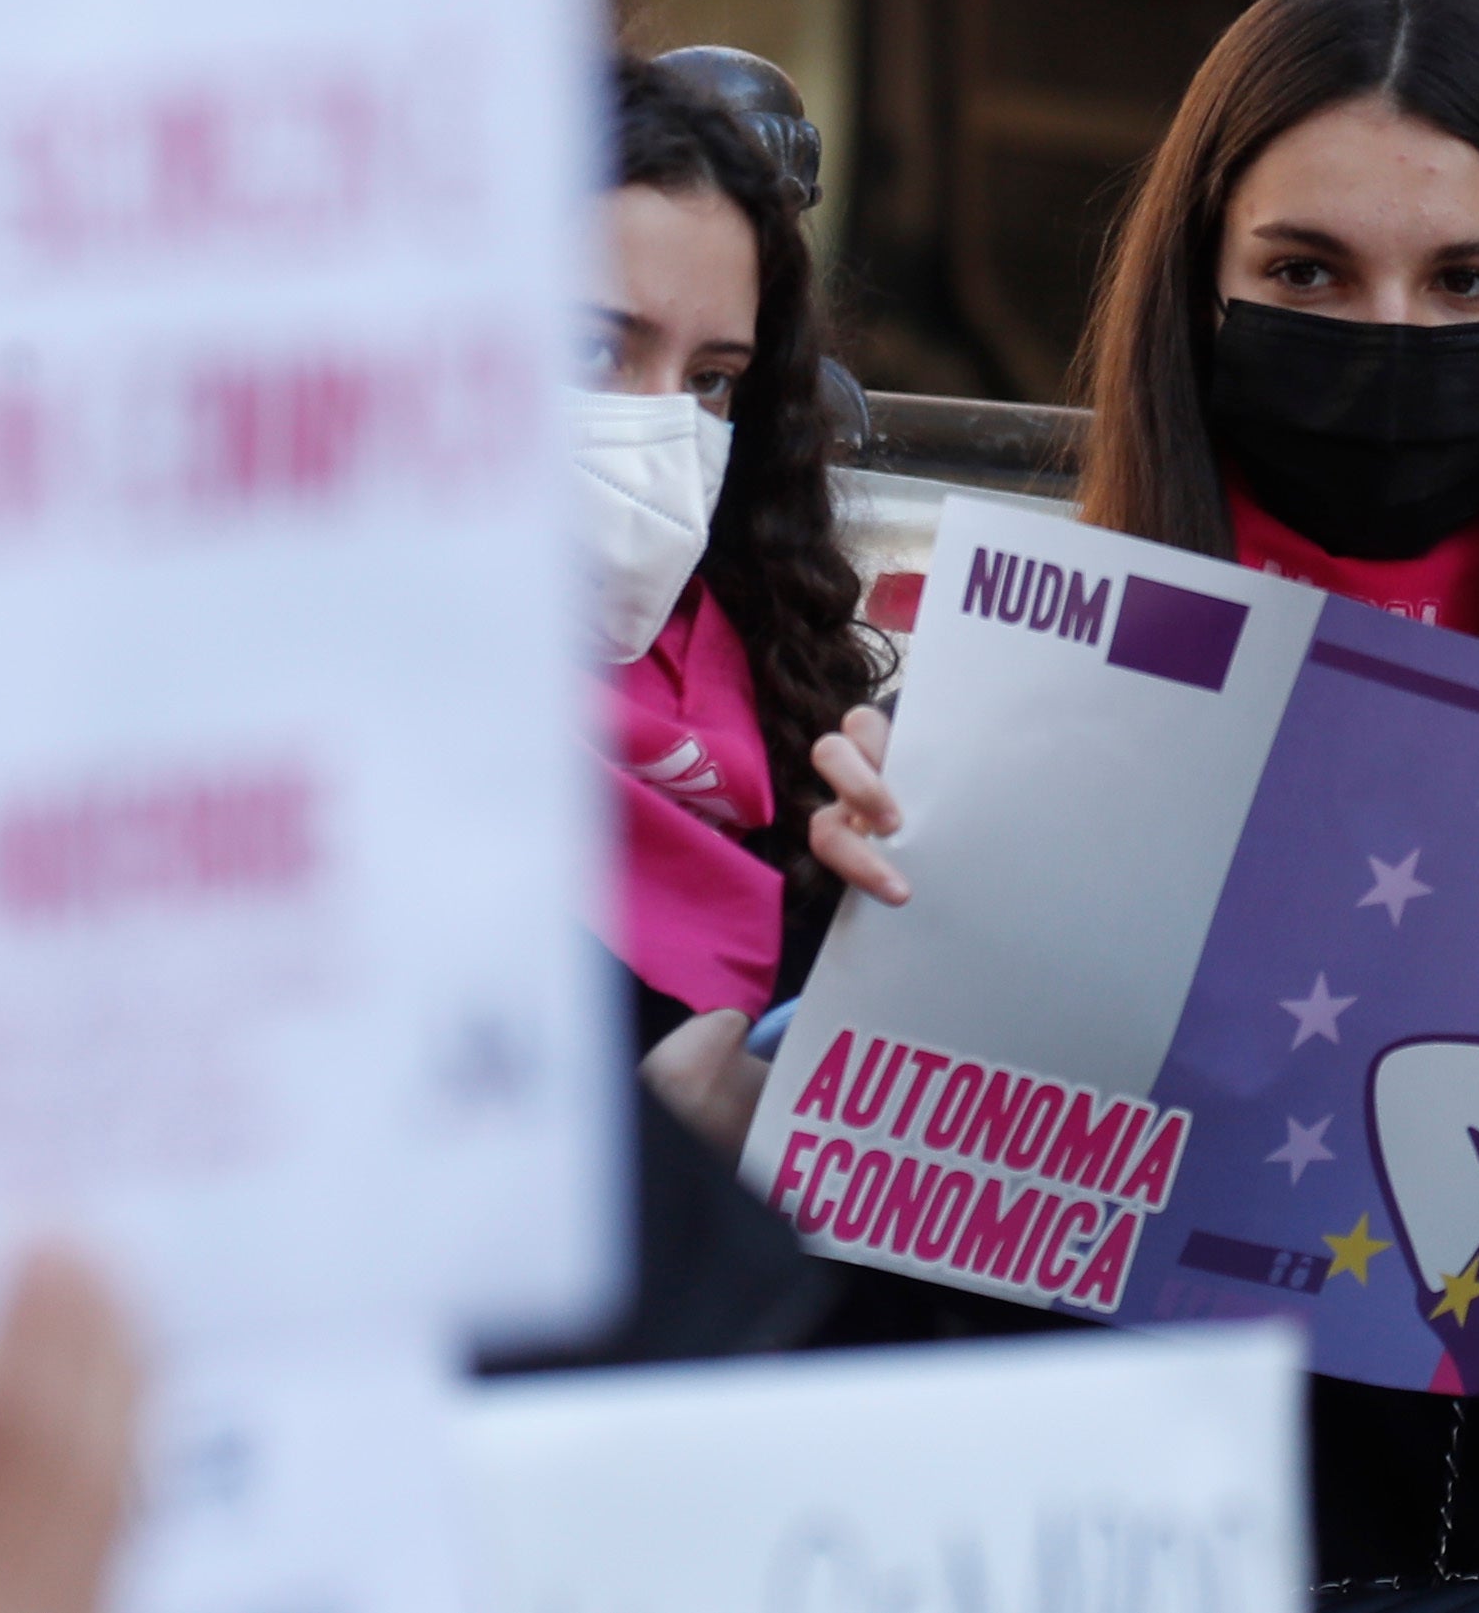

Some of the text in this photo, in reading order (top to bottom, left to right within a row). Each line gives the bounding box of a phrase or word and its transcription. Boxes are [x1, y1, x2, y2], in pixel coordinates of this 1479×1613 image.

[962, 547, 1111, 646] NUDM
[792, 1029, 1186, 1206] AUTONOMIA
[766, 1129, 1139, 1306] ECONOMICA
